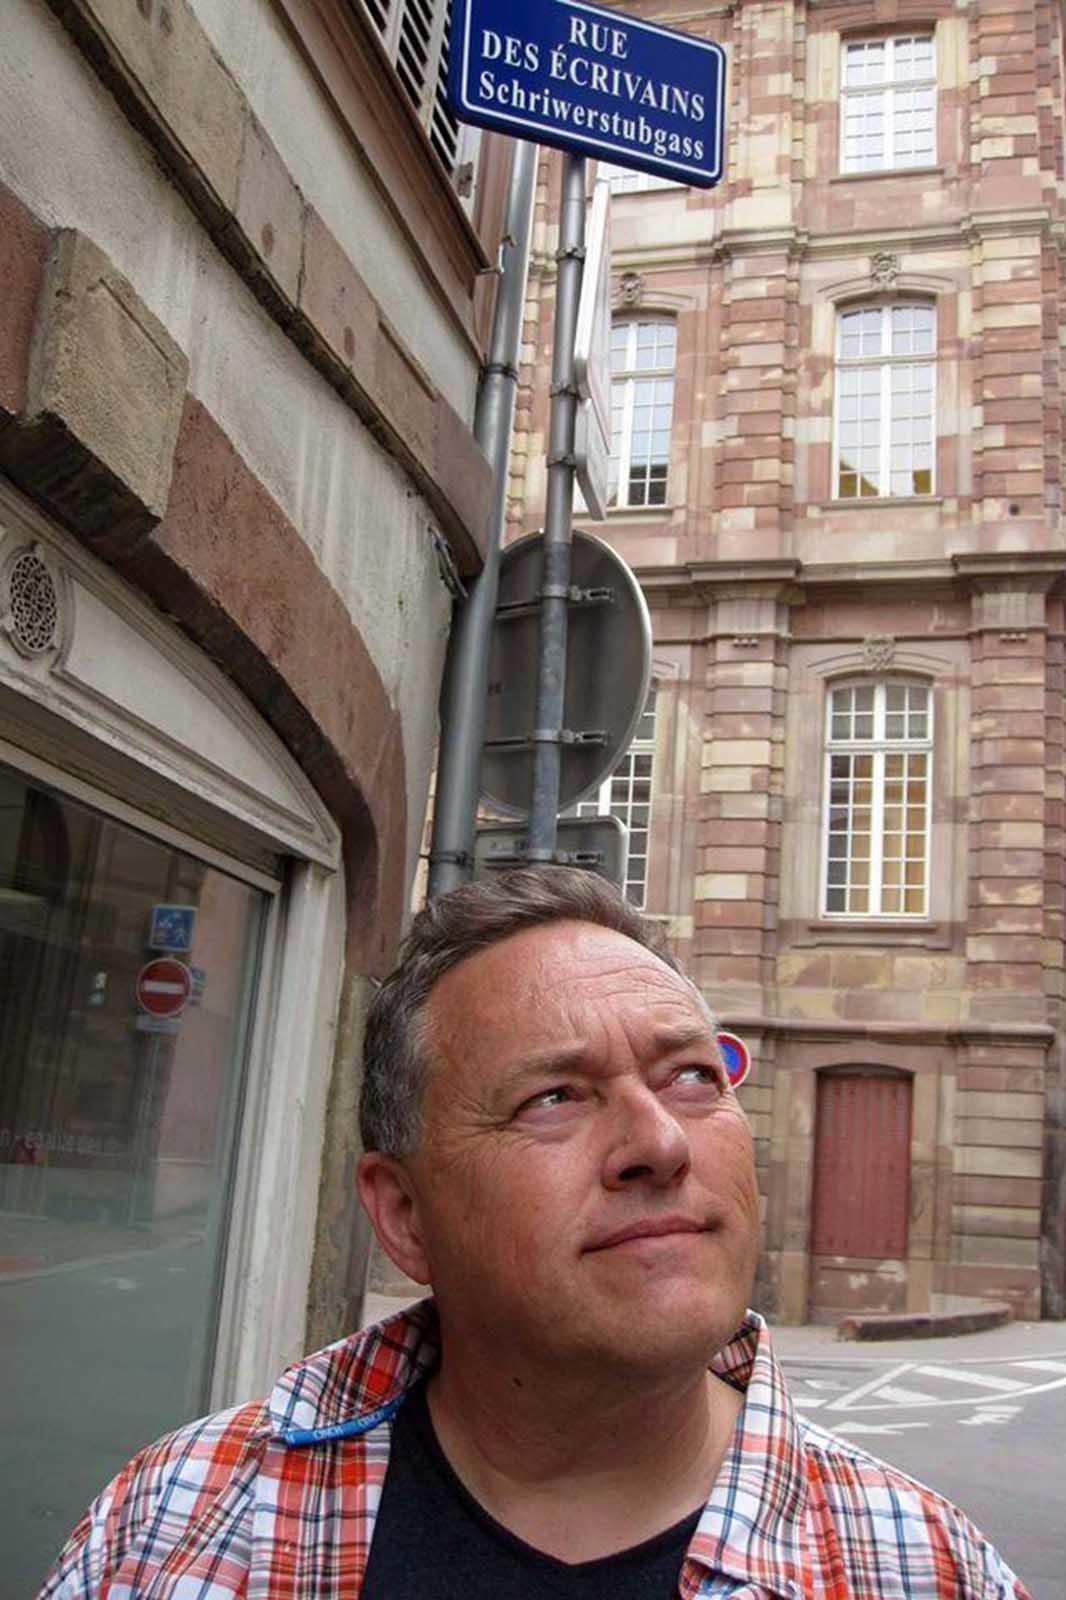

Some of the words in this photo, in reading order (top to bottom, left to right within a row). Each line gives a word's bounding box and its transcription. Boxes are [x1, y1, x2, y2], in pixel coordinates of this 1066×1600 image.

[482, 30, 539, 72] DES
[549, 43, 705, 122] ÉCRIVAINS
[570, 17, 628, 59] RUE
[479, 71, 704, 160] Schriwerstubgass
